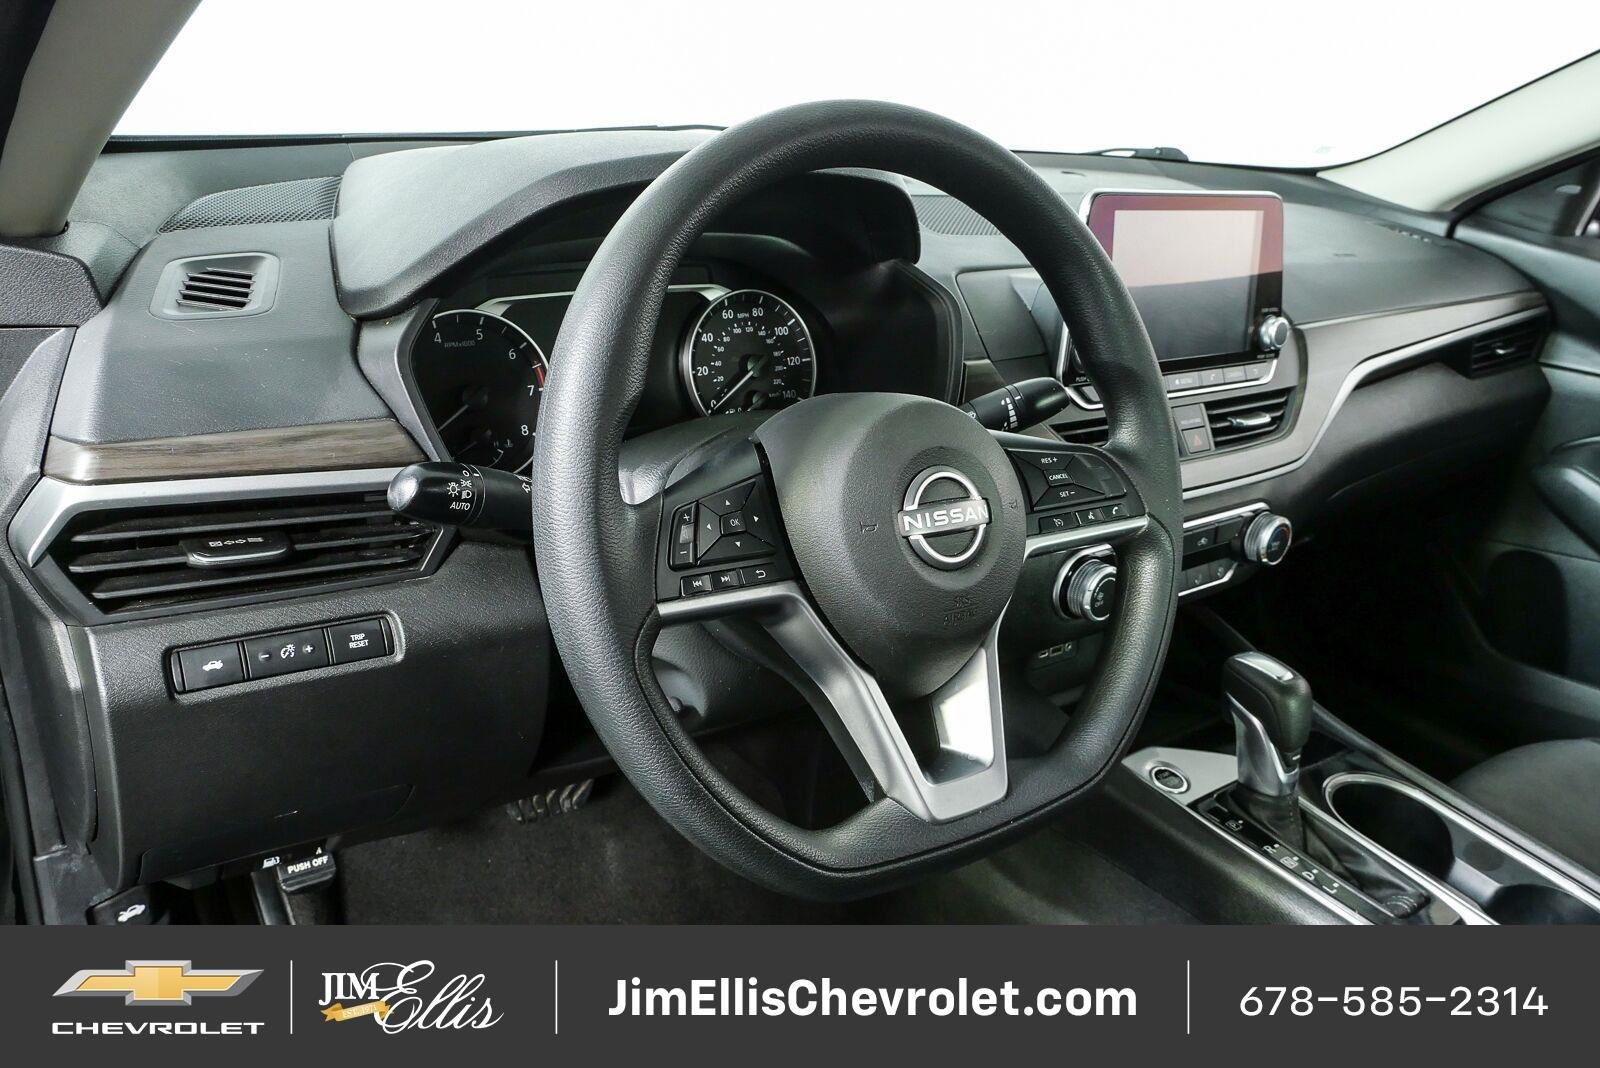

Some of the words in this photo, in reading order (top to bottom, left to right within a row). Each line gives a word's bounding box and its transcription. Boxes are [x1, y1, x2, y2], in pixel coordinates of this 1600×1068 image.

[722, 310, 734, 319] 60
[752, 307, 764, 316] 80
[476, 329, 483, 340] 5
[774, 327, 789, 336] 100
[434, 332, 442, 344] 4
[701, 333, 714, 342] 40
[508, 349, 516, 360] 6
[787, 356, 801, 366] 120
[697, 366, 709, 376] 20
[527, 385, 534, 396] 7
[782, 390, 797, 399] 140
[521, 424, 529, 436] 8
[1048, 473, 1069, 481] CANCEL
[450, 501, 470, 511] AUTO
[730, 518, 740, 527] OK
[902, 504, 988, 531] NISSAN
[350, 633, 365, 641] TRIP
[349, 639, 369, 649] RESET
[1263, 845, 1277, 854] R
[287, 860, 311, 874] PUSH
[312, 855, 328, 867] OFF
[1302, 871, 1315, 880] D
